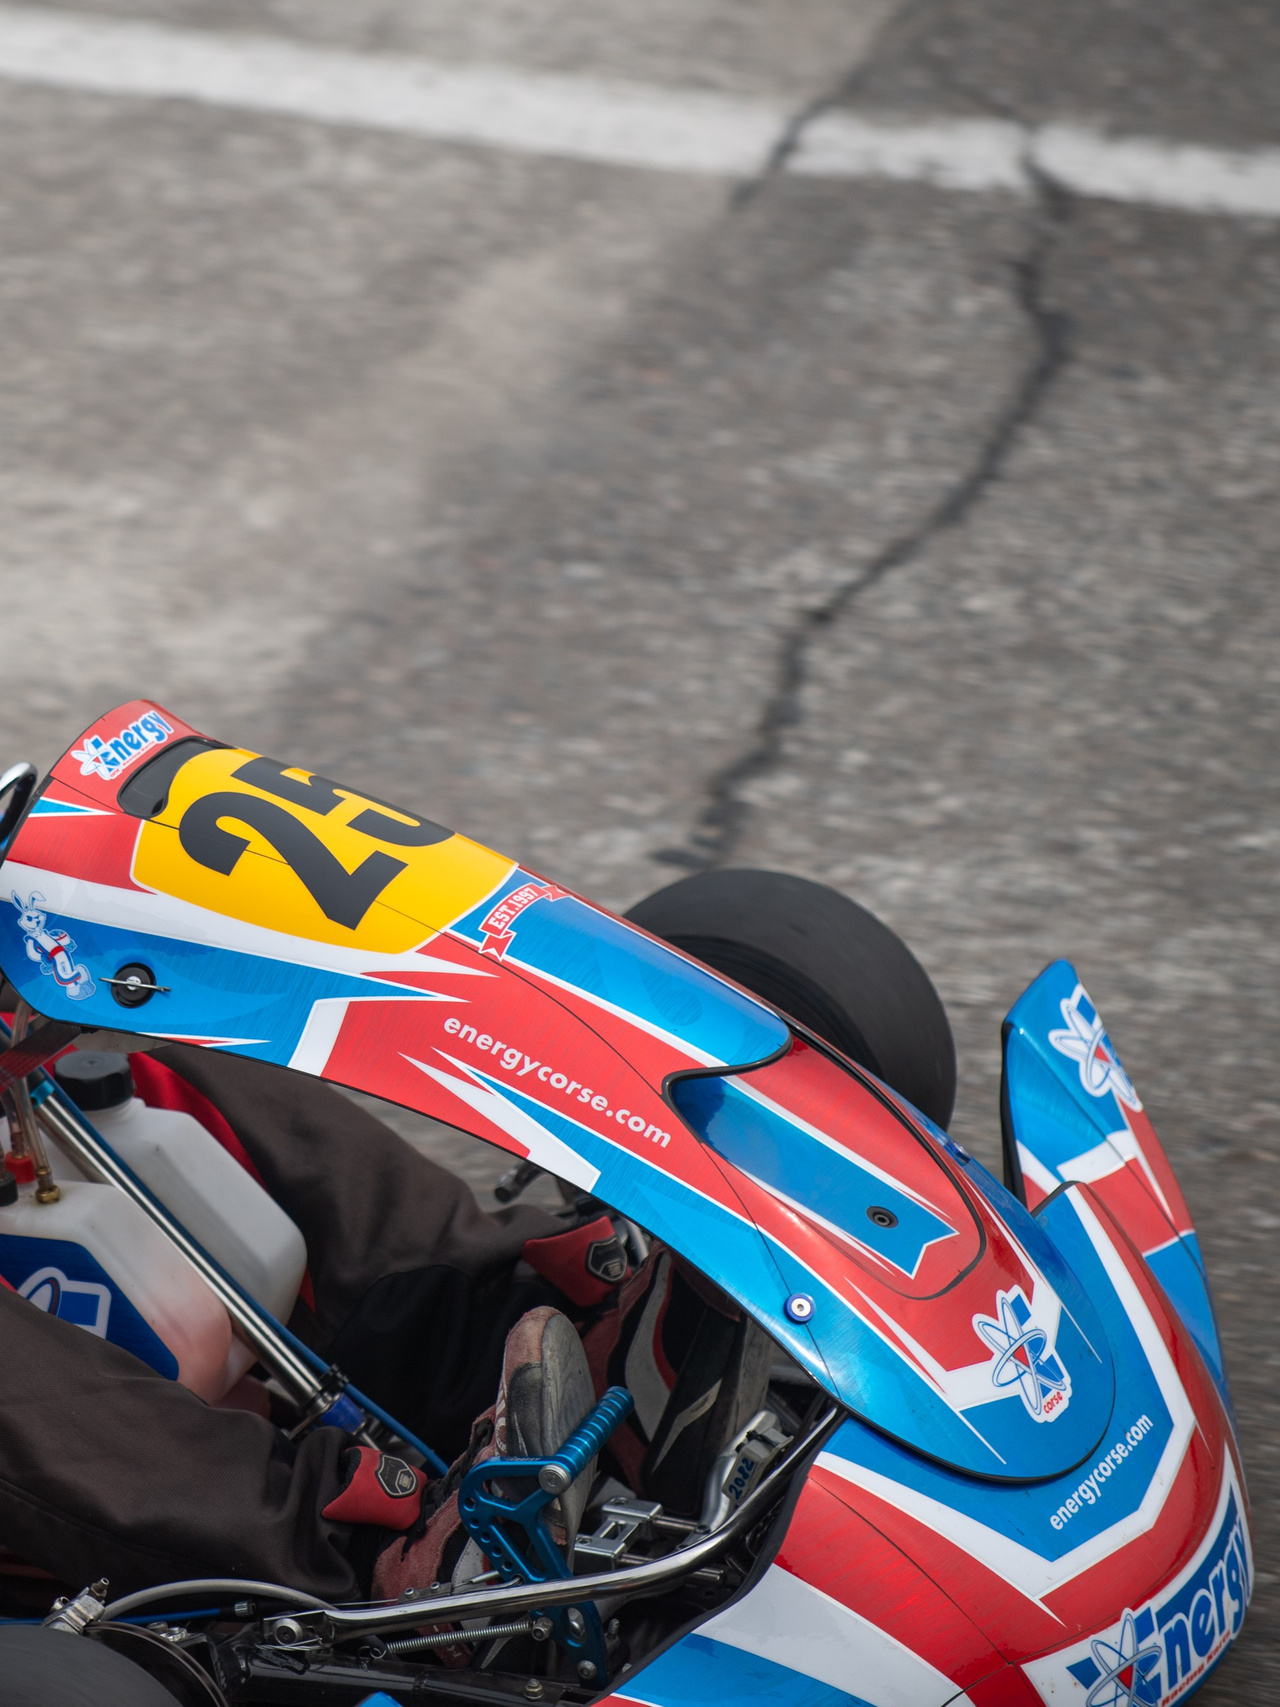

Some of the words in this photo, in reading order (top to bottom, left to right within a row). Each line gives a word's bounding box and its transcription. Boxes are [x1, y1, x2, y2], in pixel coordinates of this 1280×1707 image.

[82, 710, 173, 776] Energy
[179, 757, 457, 931] 25
[487, 887, 539, 930] EST.1997
[443, 1017, 672, 1148] energycorse.com
[1043, 1391, 1063, 1414] corse
[1049, 1414, 1154, 1531] energycorse.com
[1115, 1510, 1253, 1707] Energy
